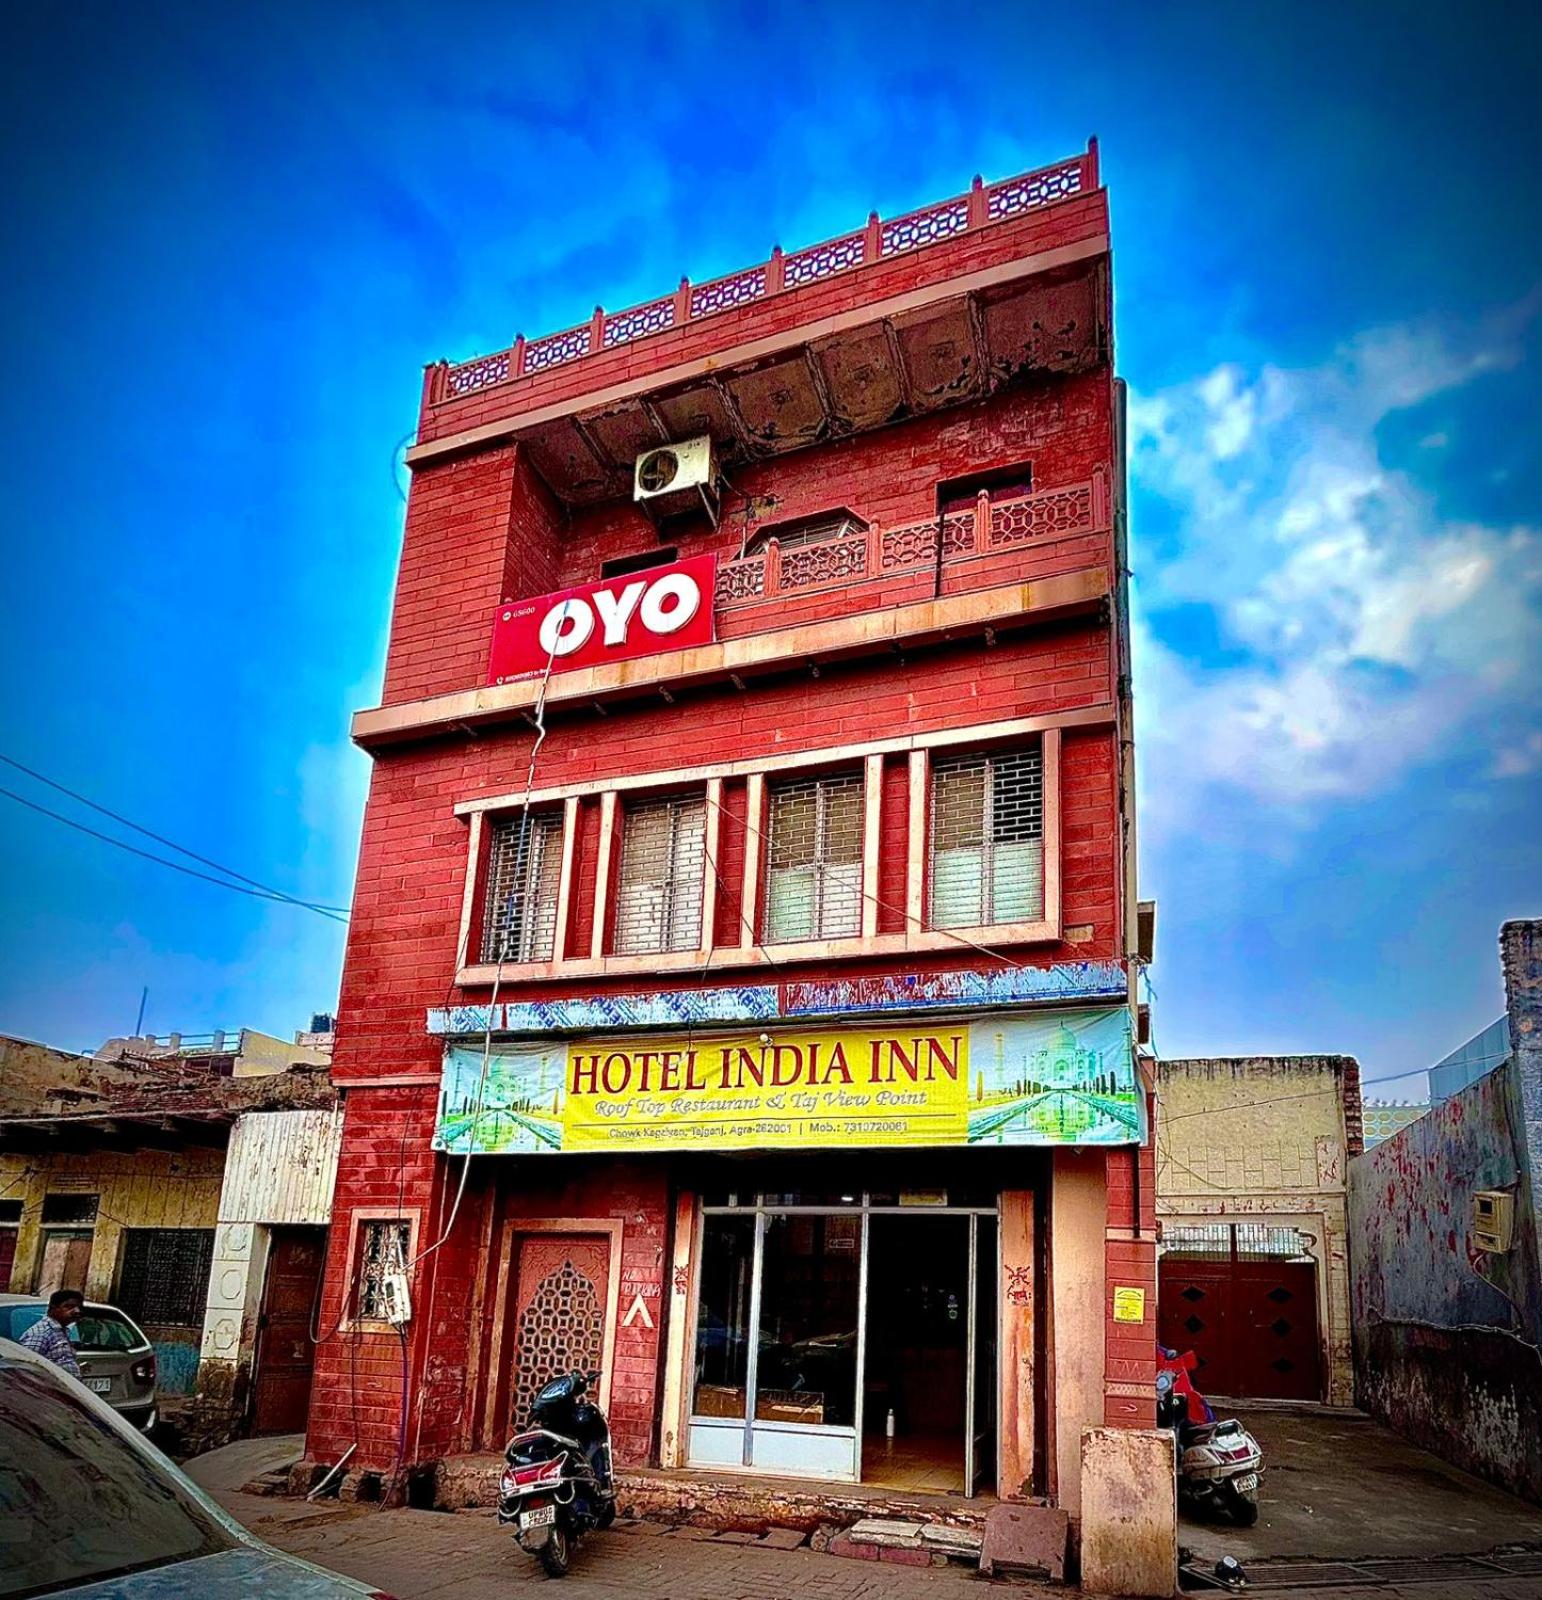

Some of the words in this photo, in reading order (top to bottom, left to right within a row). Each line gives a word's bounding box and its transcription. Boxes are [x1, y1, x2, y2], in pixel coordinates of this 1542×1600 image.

[539, 573, 701, 656] OYO
[571, 1051, 707, 1095] HOTEL
[718, 1042, 854, 1090] INDIA
[868, 1037, 962, 1083] INN
[595, 1098, 635, 1118] Roof
[636, 1097, 666, 1117] Top
[671, 1095, 761, 1114] Restaurant
[766, 1091, 787, 1109] &
[790, 1091, 820, 1113] Taj
[823, 1090, 870, 1107] View
[876, 1089, 928, 1106] Point
